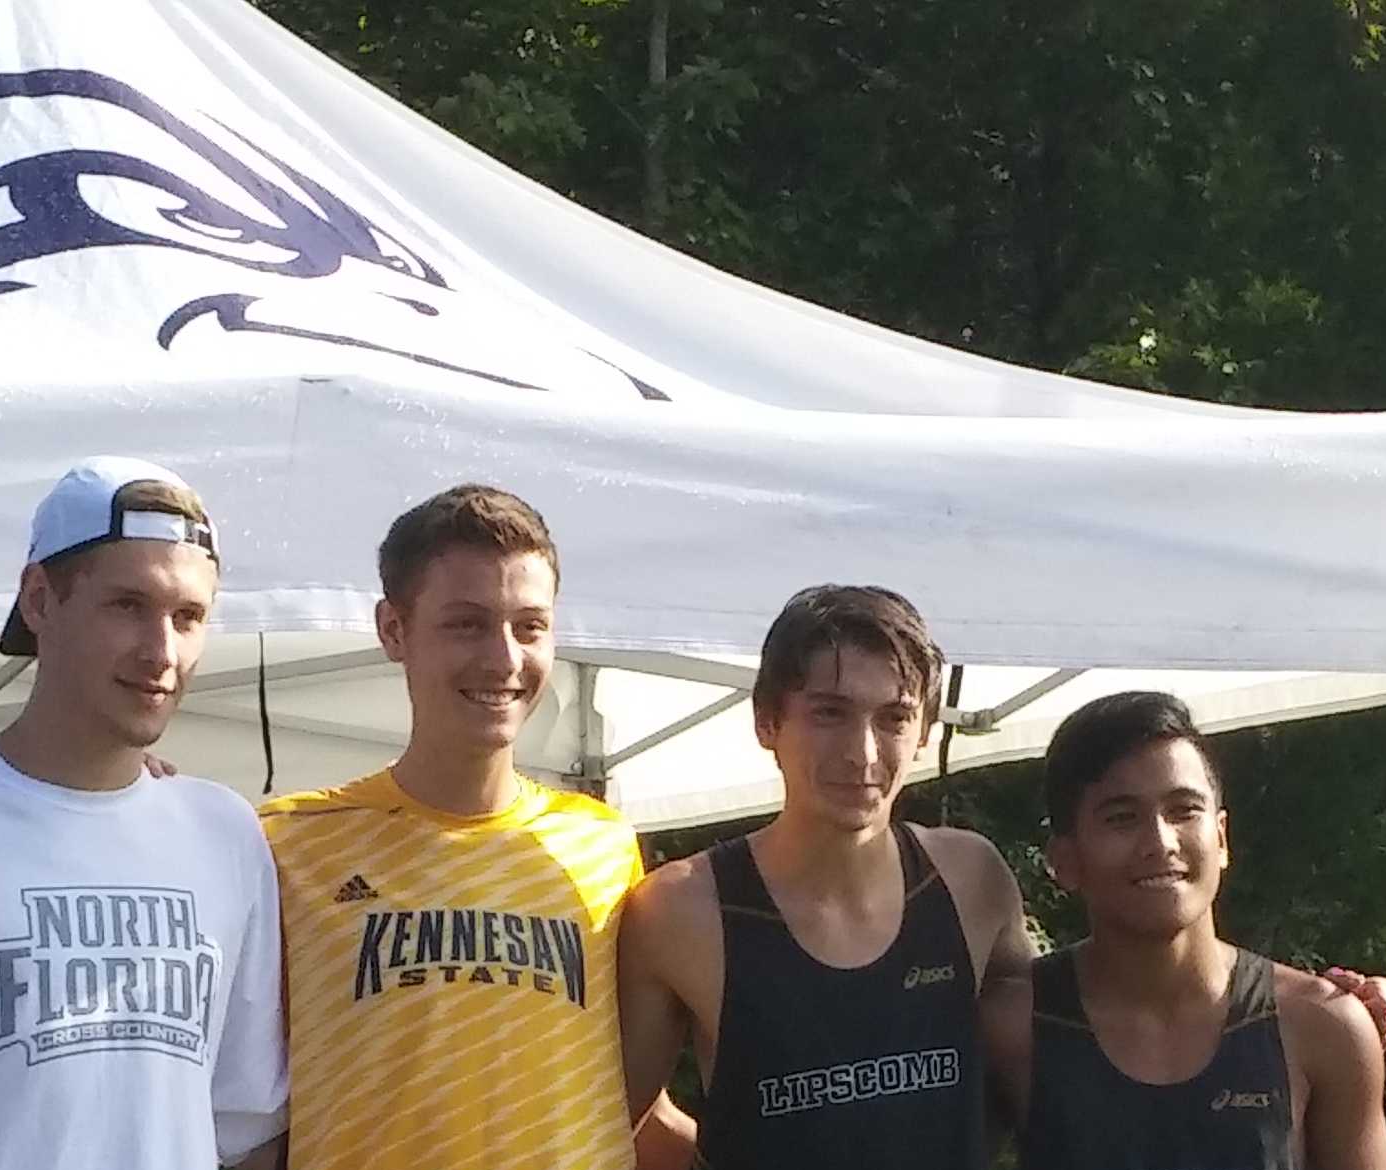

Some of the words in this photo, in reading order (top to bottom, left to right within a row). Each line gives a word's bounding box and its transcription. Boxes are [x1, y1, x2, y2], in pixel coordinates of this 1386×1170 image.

[32, 894, 193, 951] NORTH
[354, 908, 587, 1010] KENNESAW
[397, 965, 556, 996] STATE
[37, 1024, 109, 1050] CROSS
[112, 1021, 199, 1050] COUNTRY
[758, 1048, 961, 1117] LIPSCOMB
